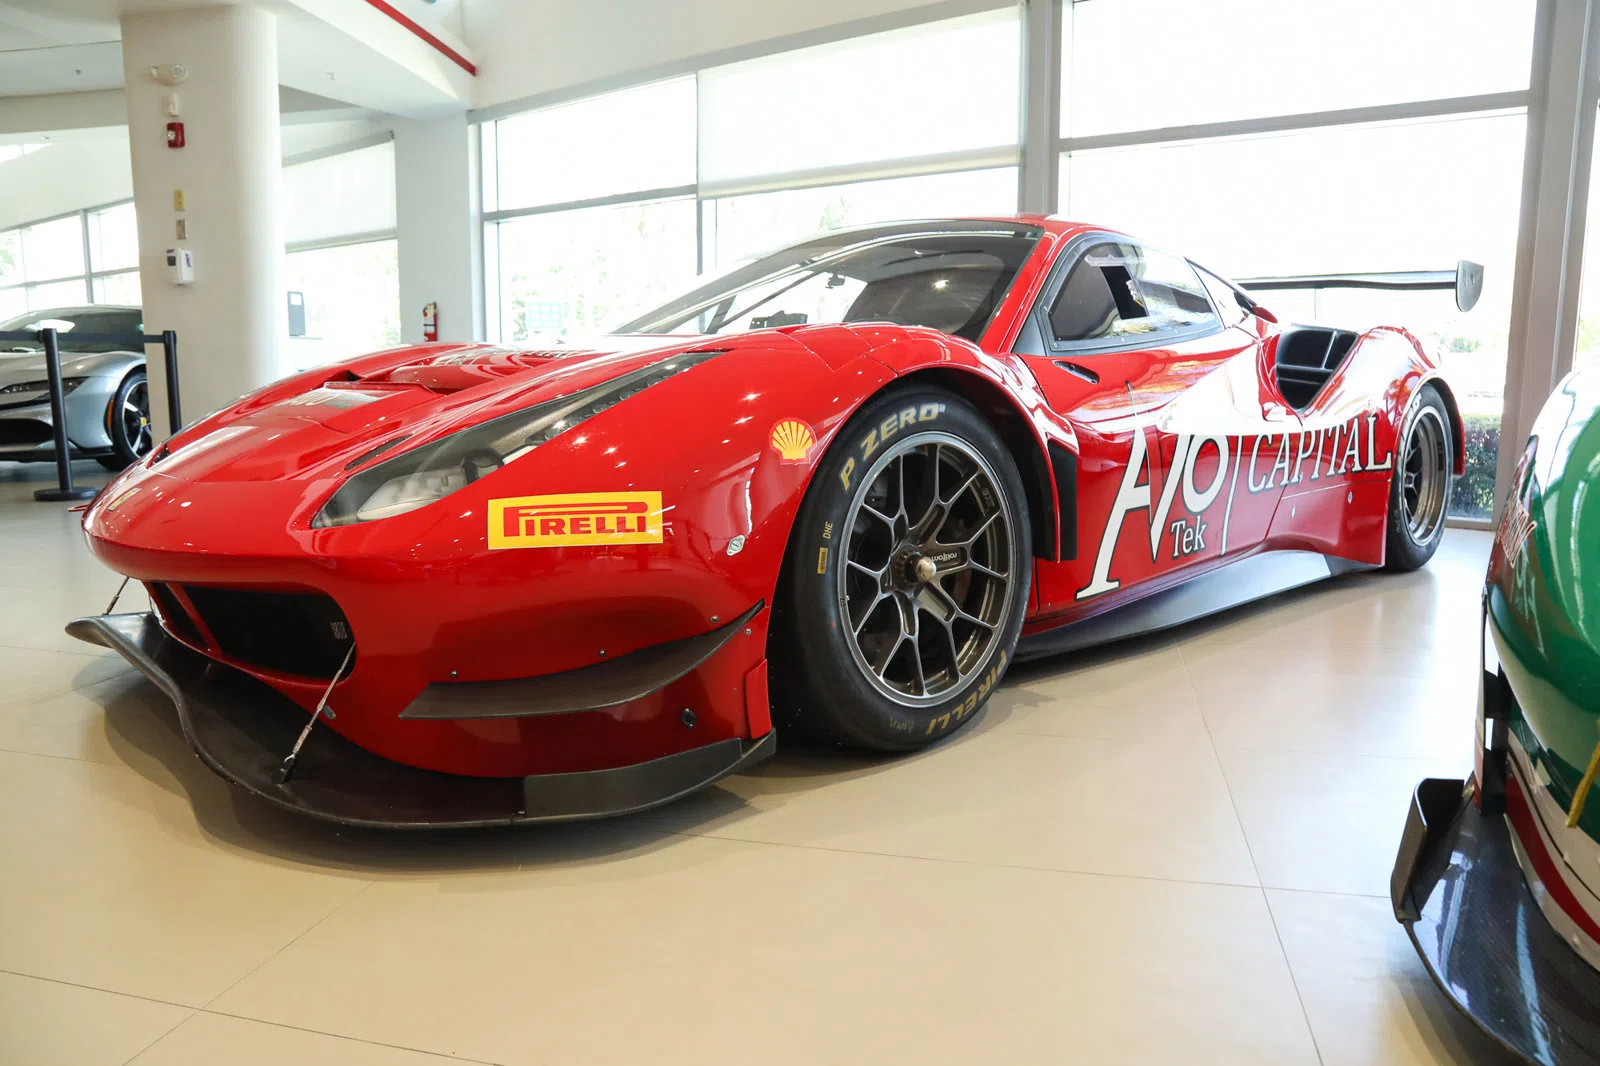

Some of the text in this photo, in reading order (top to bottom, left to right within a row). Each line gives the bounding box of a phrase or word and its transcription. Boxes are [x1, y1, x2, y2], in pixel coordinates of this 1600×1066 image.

[838, 402, 941, 491] P ZERO
[1248, 416, 1392, 493] CAPITAL
[503, 501, 648, 538] PIRELLI
[1170, 514, 1208, 560] Tek
[925, 649, 1007, 736] PIRELLI
